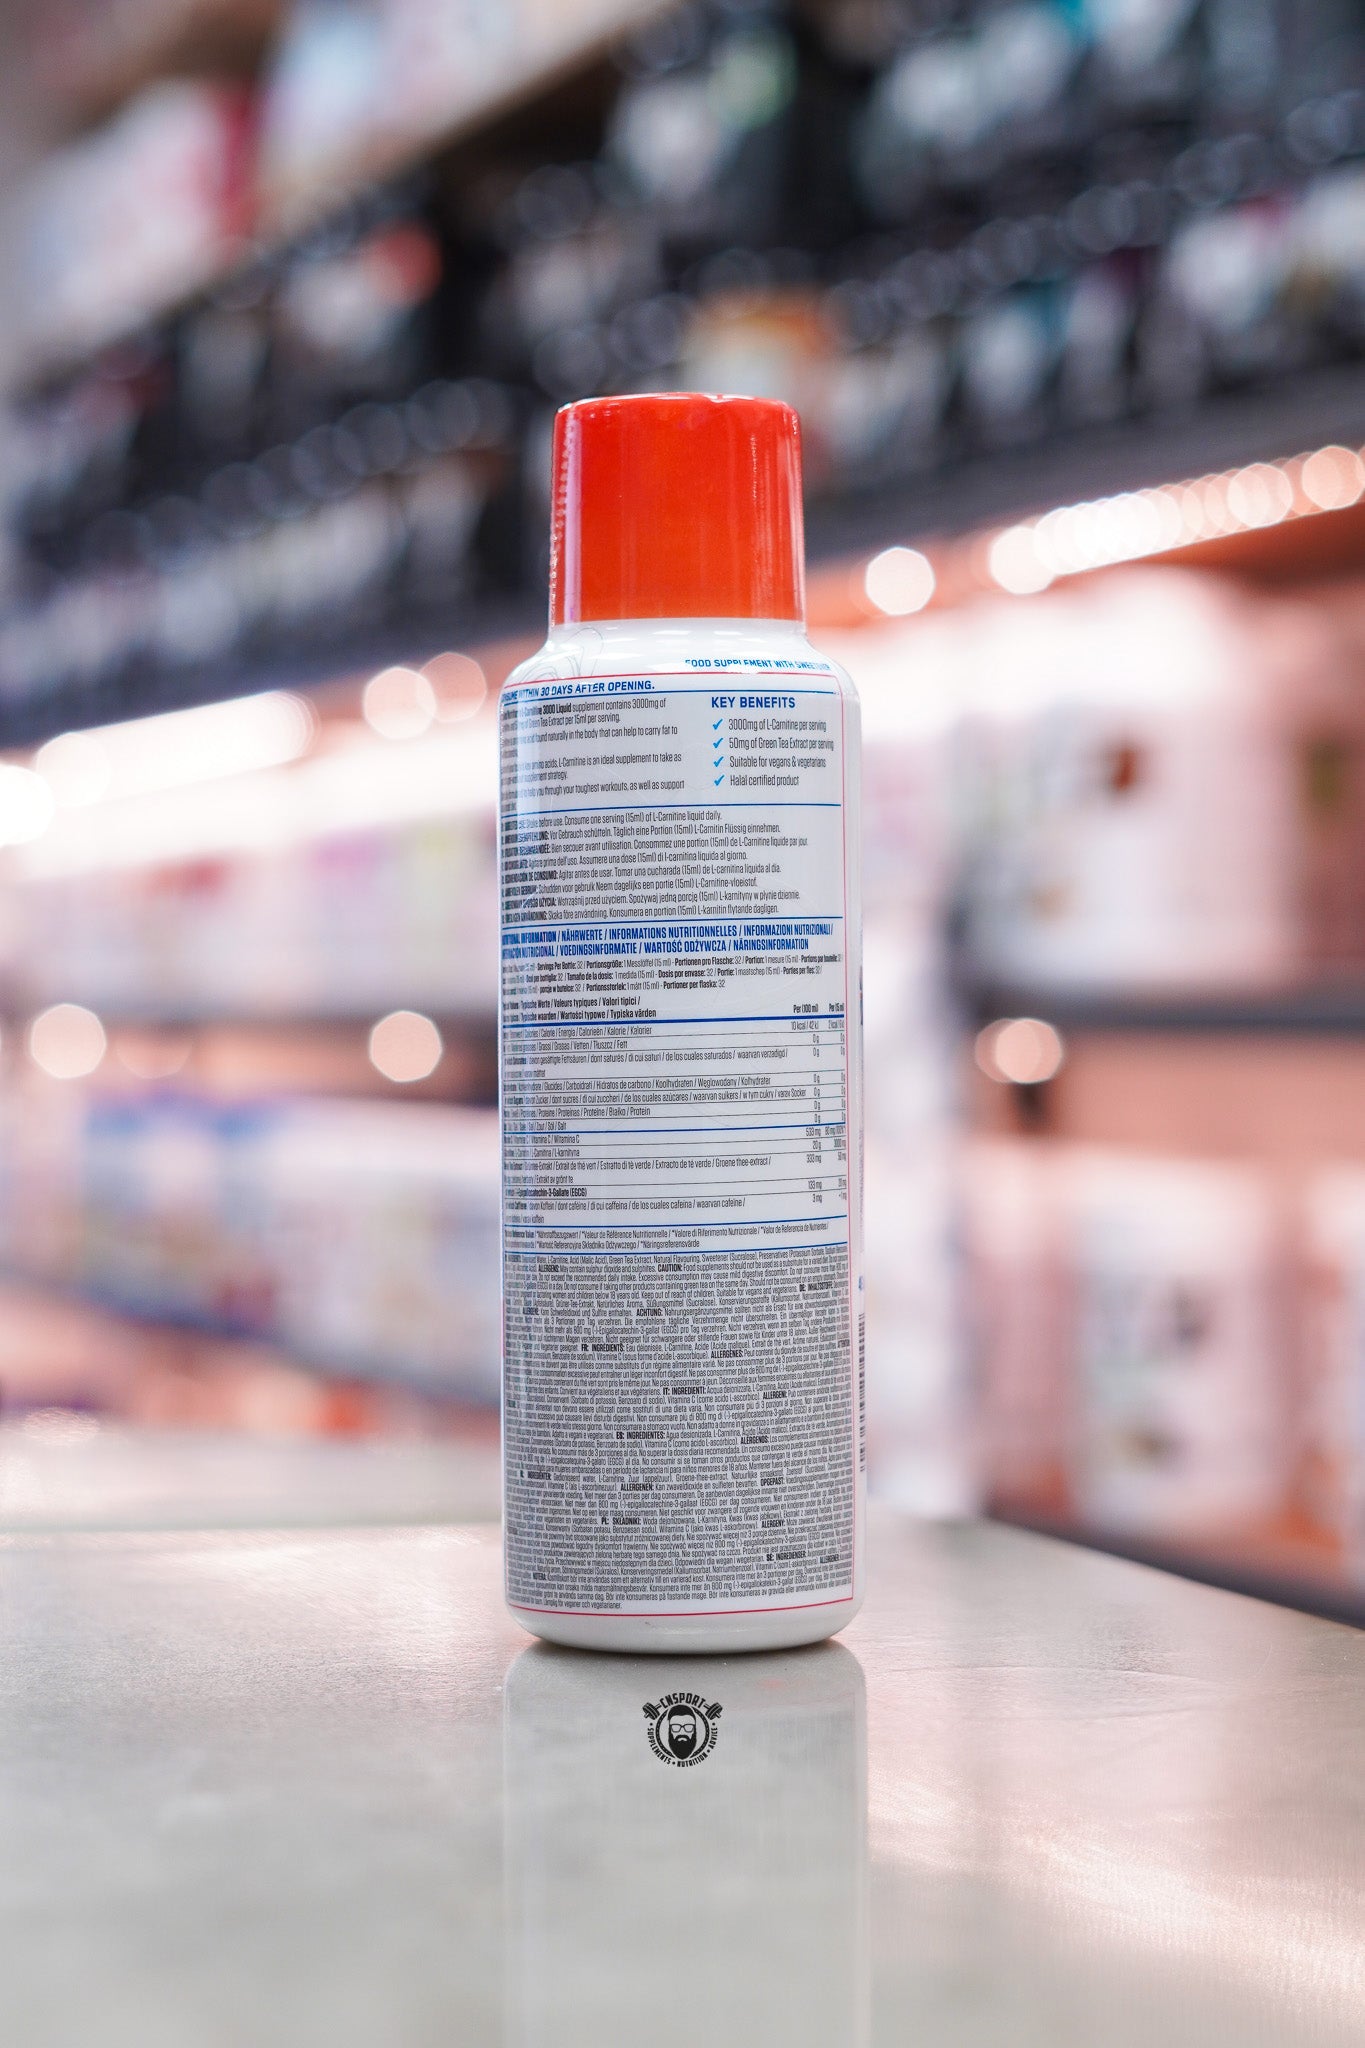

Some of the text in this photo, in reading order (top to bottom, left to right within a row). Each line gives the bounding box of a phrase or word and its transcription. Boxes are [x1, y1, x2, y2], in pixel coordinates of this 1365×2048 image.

[541, 686, 550, 697] 30
[552, 684, 573, 696] DAYS
[575, 682, 605, 694] AFTER
[608, 680, 655, 692] OPENING.
[543, 704, 555, 715] 3000
[556, 703, 572, 715] Liquid
[572, 700, 605, 713] supplement
[606, 699, 631, 710] contains
[632, 698, 659, 710] 3000mg
[659, 698, 666, 708] of
[711, 697, 796, 708] KEY BENEFITS
[549, 716, 564, 727] Extract
[565, 717, 574, 728] per
[574, 713, 586, 725] 15ml
[588, 715, 596, 727] per
[598, 713, 620, 724] serving.
[729, 718, 826, 732] 3000mg of L-Carnitine per serving
[548, 729, 568, 742] naturally
[569, 730, 574, 740] in
[574, 729, 583, 740] the
[585, 728, 598, 740] body
[600, 727, 610, 738] that
[612, 728, 622, 737] can
[624, 726, 637, 738] help
[638, 726, 644, 736] to
[645, 726, 661, 737] carry
[662, 725, 670, 735] fat
[671, 725, 677, 735] to
[729, 737, 834, 751] 50mg of Green Tea Extract per serving
[558, 756, 586, 768] L-Carnitine
[587, 756, 592, 766] is
[593, 756, 600, 765] an
[601, 754, 615, 765] ideal
[616, 754, 651, 766] supplement
[652, 753, 659, 763] to
[660, 752, 673, 762] take
[674, 753, 682, 762] as
[730, 756, 826, 768] Suitable for vegans & vegetarians
[548, 771, 567, 781] strategy.
[730, 774, 799, 787] Halal certified product
[564, 780, 684, 794] your toughest workouts, as well as support
[553, 816, 563, 826] use.
[565, 815, 590, 826] Consume
[591, 815, 601, 825] one
[602, 813, 624, 825] serving
[625, 812, 644, 823] (15ml)
[645, 812, 651, 822] of
[653, 811, 686, 822] L-Carnitine
[687, 811, 705, 822] liquid
[706, 810, 722, 821] daily.
[550, 823, 780, 839] Vor Gebrauch schütteln. Täglich eine Portion (15ml) L-Carnitin Flüssig einnehmen.
[562, 883, 573, 893] voor
[574, 882, 594, 893] gebruik
[596, 880, 613, 891] Neem
[614, 879, 641, 892] dagelijks
[642, 879, 654, 889] een
[655, 877, 673, 889] portie
[675, 877, 694, 889] (15ml)
[695, 876, 757, 888] L-Carnitine-vloeistof.
[561, 928, 603, 942] NÄHRWERTE
[609, 926, 667, 940] INFORMATIONS
[669, 924, 737, 938] NUTRITIONNELLES
[743, 923, 793, 937] INFORMAZIONI
[794, 923, 830, 936] NUTRIZIONALI
[560, 942, 637, 957] VOEDINGSINFORMATIE
[644, 939, 682, 954] WARTOŚĆ
[684, 939, 726, 953] ODŻYWCZA
[733, 938, 809, 951] NÄRINGSINFORMATION
[586, 960, 623, 969] Portionsgröße:
[663, 978, 725, 989] Portioner per flaska: 32
[561, 1008, 656, 1020] Wartości typowe Typiska värden
[793, 1005, 801, 1013] Per
[574, 1040, 628, 1050] Vetten Tłuszcz Fett
[609, 1107, 626, 1116] Białko
[630, 1106, 650, 1115] Protein
[806, 1127, 821, 1137] 533 mg
[554, 1135, 580, 1144] Witamina C
[812, 1140, 818, 1150] 20
[658, 1264, 682, 1272] CAUTION:
[636, 1308, 662, 1317] ACHTUNG:
[581, 1344, 589, 1352] FR:
[672, 1386, 706, 1395] INGREDIENTI:
[626, 1431, 665, 1439] INGREDIENTES:
[620, 1483, 654, 1491] ALLERGENEN:
[601, 1517, 609, 1525] PL:
[761, 1519, 785, 1528] ALERGENY:
